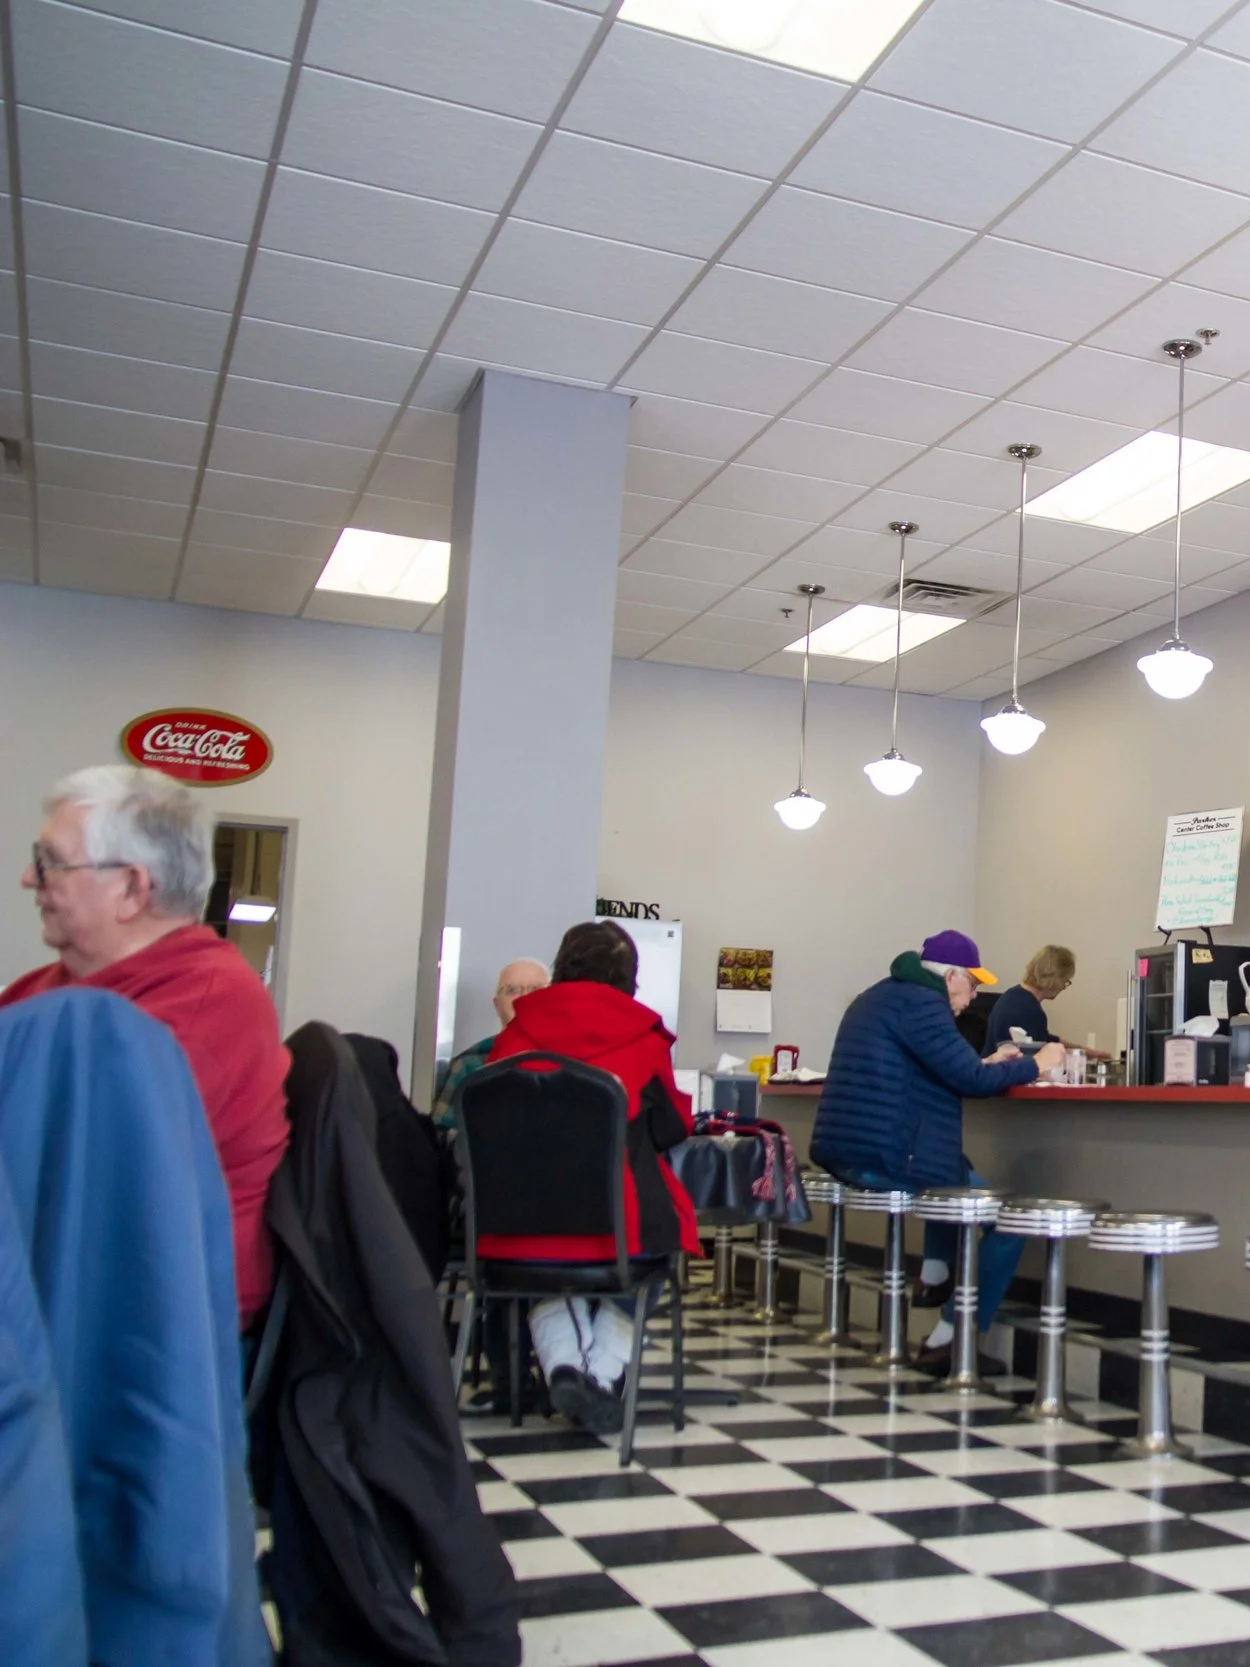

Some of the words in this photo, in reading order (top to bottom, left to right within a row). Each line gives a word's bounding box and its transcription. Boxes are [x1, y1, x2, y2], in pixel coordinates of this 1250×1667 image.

[174, 721, 207, 731] DRINK
[142, 722, 251, 761] Coca-Cola
[143, 753, 185, 765] DELICIOUS
[185, 757, 202, 767] AND
[202, 759, 251, 771] REFRESHING
[1191, 816, 1216, 826] Parker
